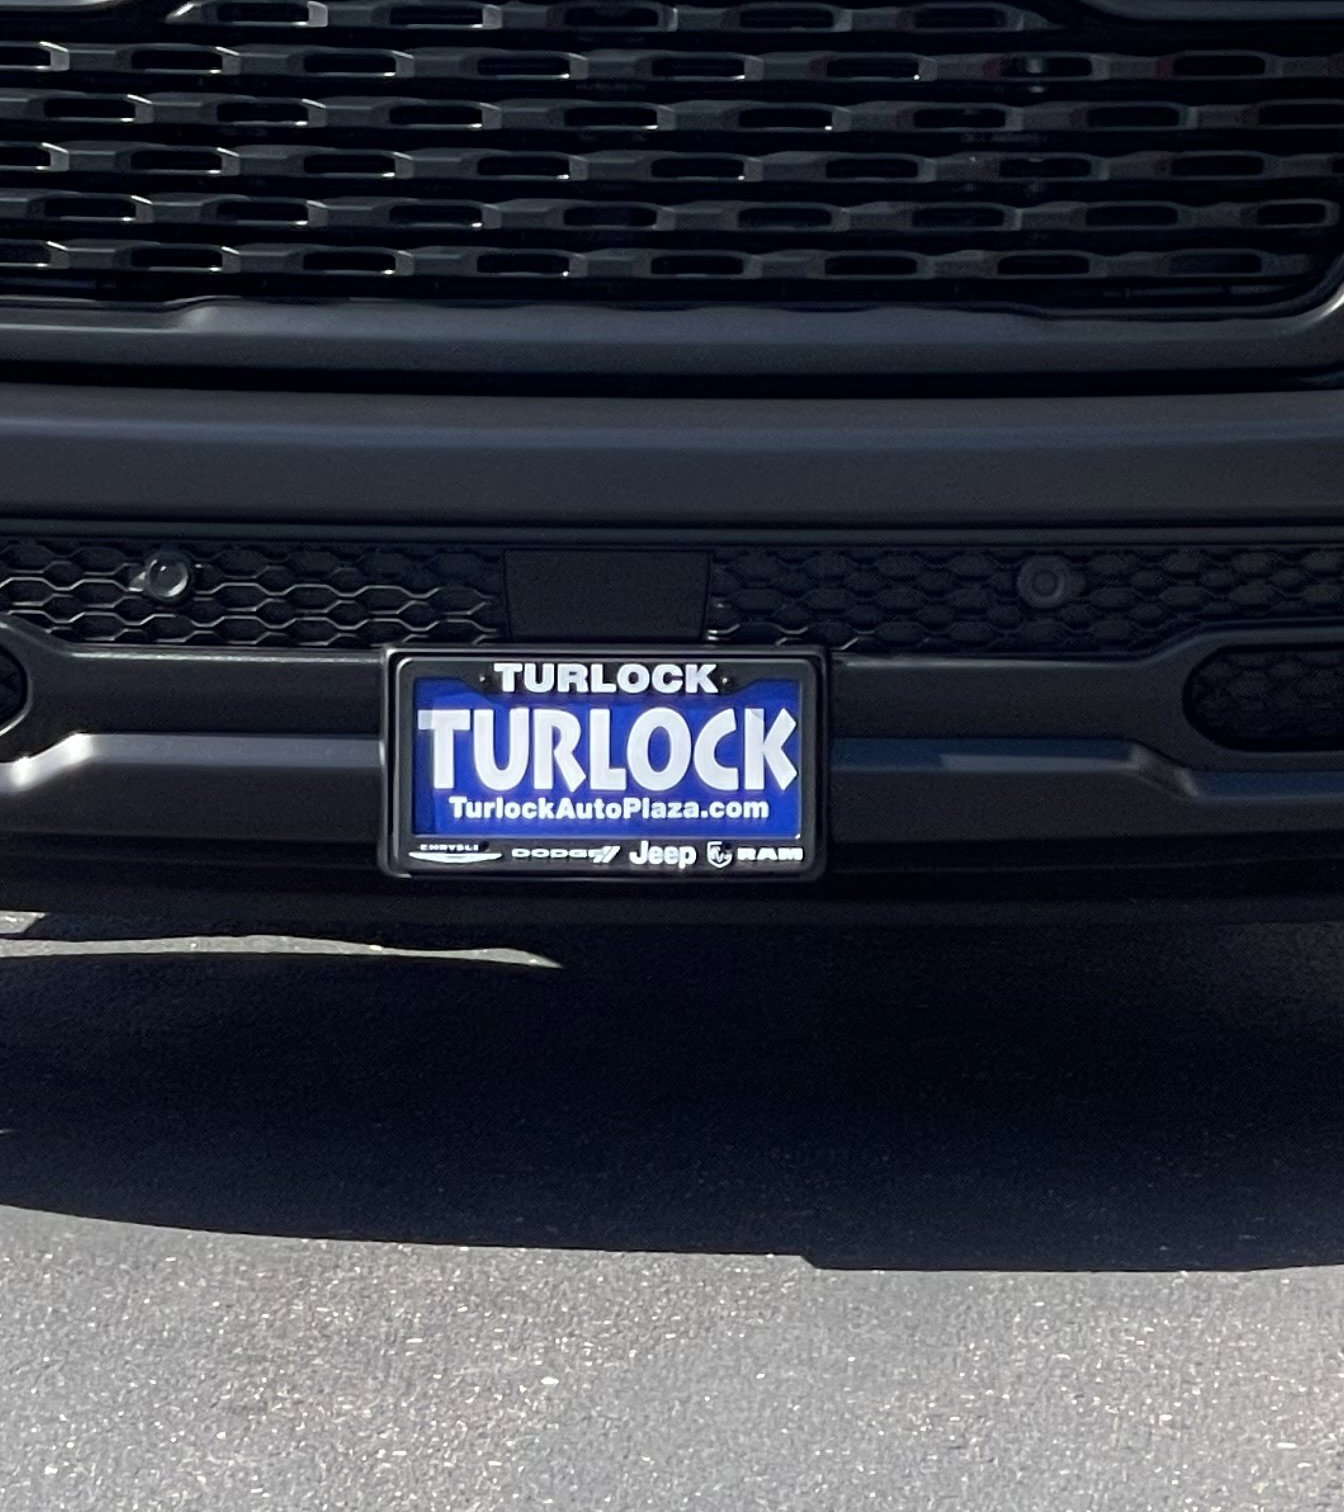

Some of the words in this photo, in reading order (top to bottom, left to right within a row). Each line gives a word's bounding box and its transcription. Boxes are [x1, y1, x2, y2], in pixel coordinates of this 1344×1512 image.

[493, 662, 719, 694] TURLOCK
[417, 706, 798, 793] TURLOCK
[448, 795, 769, 820] TurlockAutoPlaza.com
[628, 840, 698, 870] Jeep
[736, 847, 804, 861] RAM
